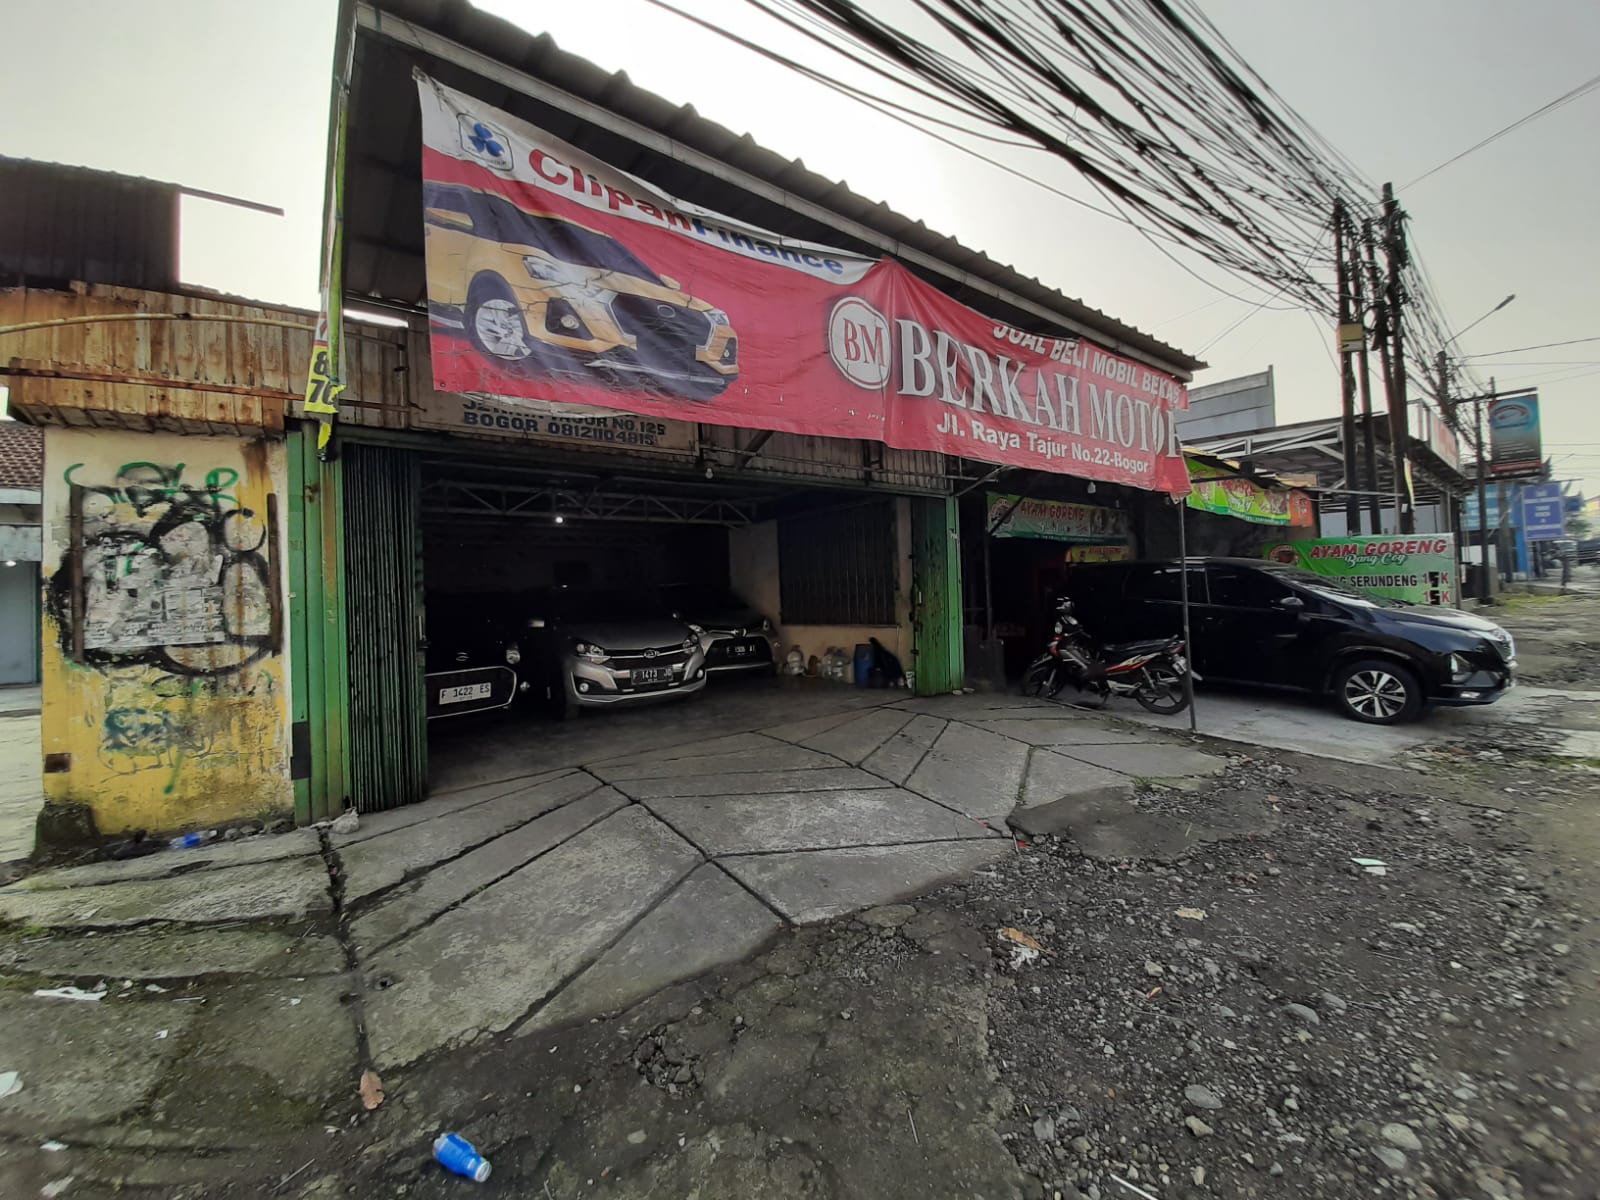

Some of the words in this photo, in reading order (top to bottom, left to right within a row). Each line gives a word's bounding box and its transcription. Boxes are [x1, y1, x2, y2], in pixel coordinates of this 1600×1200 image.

[843, 317, 887, 368] BM
[993, 325, 1046, 354] JUAL
[1050, 339, 1089, 369] BELI
[1092, 354, 1139, 388] MOBIL
[1142, 371, 1181, 404] BEKAS
[895, 318, 1082, 436] BERKAH
[463, 411, 538, 432] BOGOR
[936, 411, 965, 437] Jl.
[971, 420, 1020, 450] Raya
[1026, 431, 1067, 460] Tajur
[1050, 504, 1085, 521] GORENG
[1310, 543, 1357, 558] AYAM
[1364, 539, 1447, 556] GORENG
[1344, 554, 1378, 568] Bang
[1350, 574, 1417, 587] SERUNDENG
